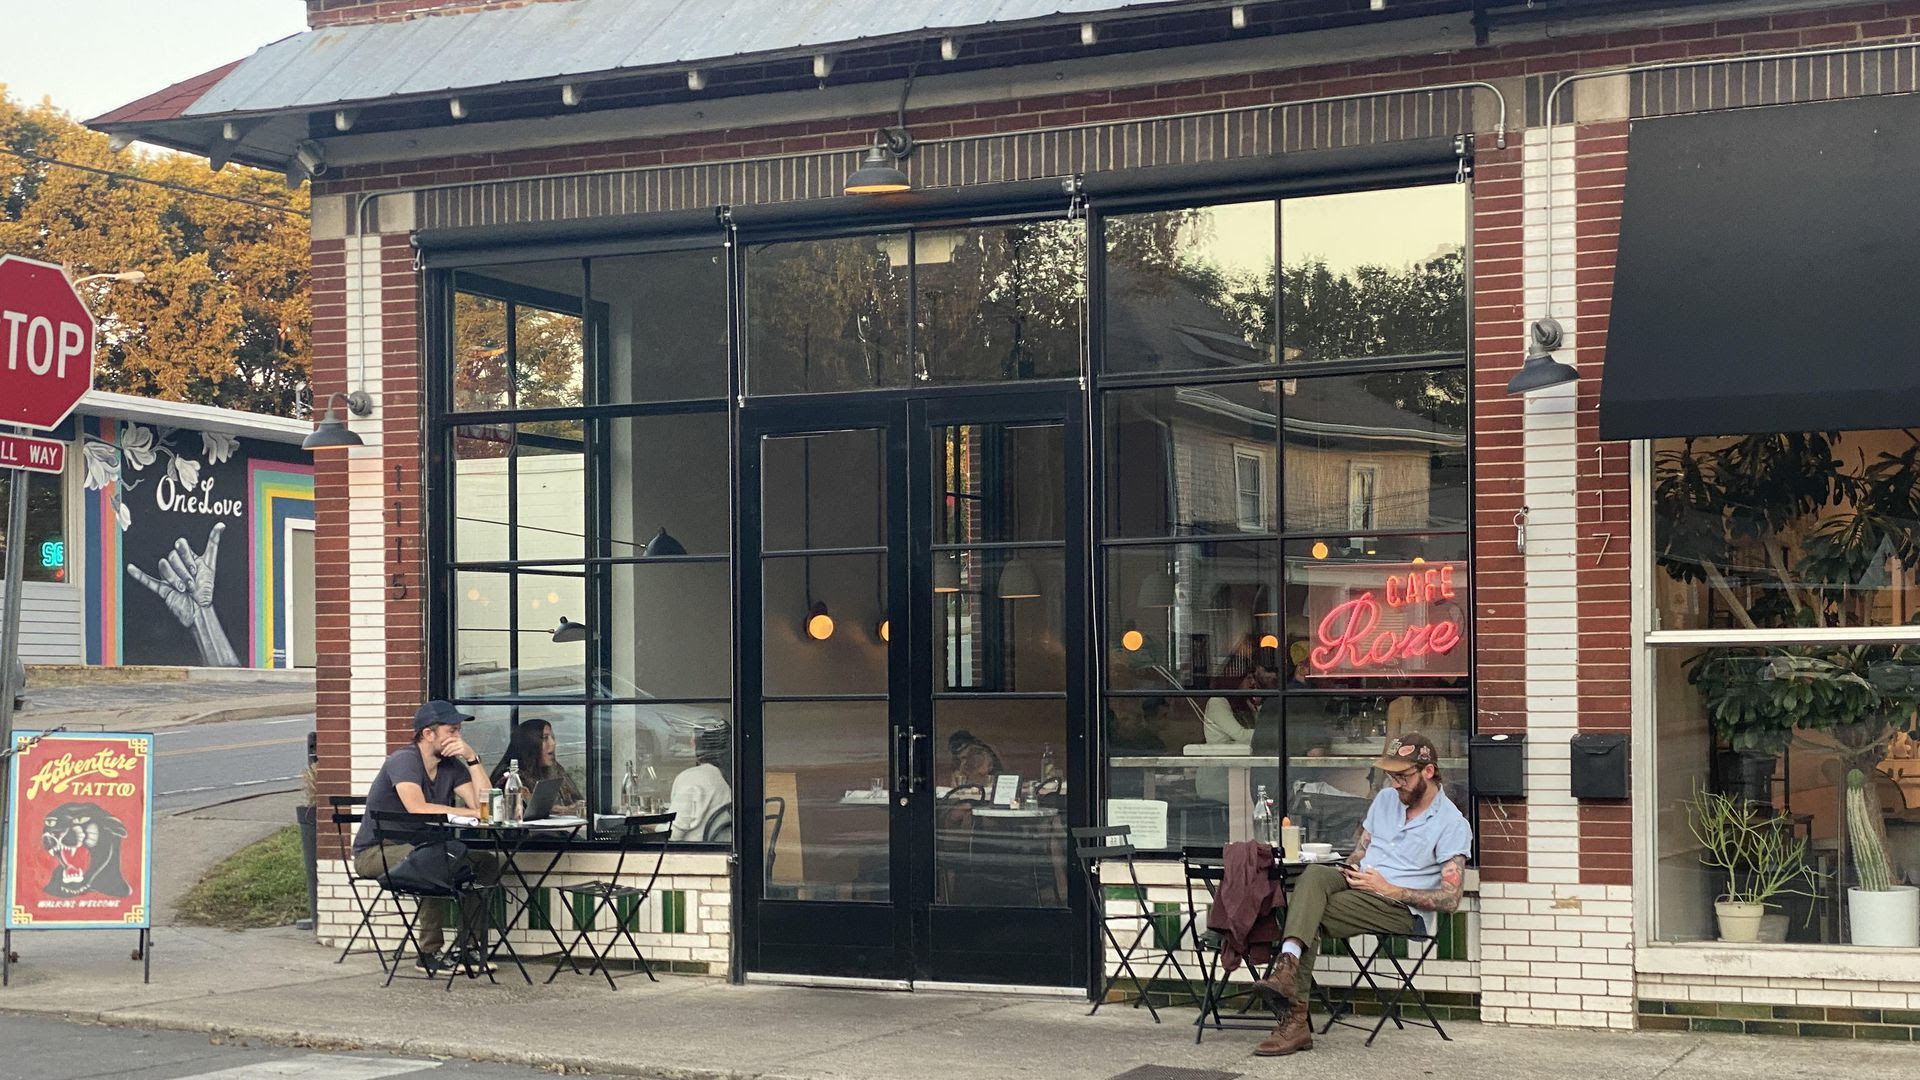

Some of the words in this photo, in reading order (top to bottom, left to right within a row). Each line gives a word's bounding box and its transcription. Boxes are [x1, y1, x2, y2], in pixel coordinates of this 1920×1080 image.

[3, 310, 84, 378] TOP
[1, 441, 18, 461] LL
[30, 444, 58, 466] WAY
[156, 474, 198, 513] One
[198, 476, 242, 517] Love
[1592, 403, 1611, 565] 117
[393, 464, 407, 600] 1115
[1386, 566, 1456, 608] CAFE
[1311, 591, 1460, 670] Roze
[26, 747, 138, 800] Adventure
[71, 782, 136, 797] TATTOO
